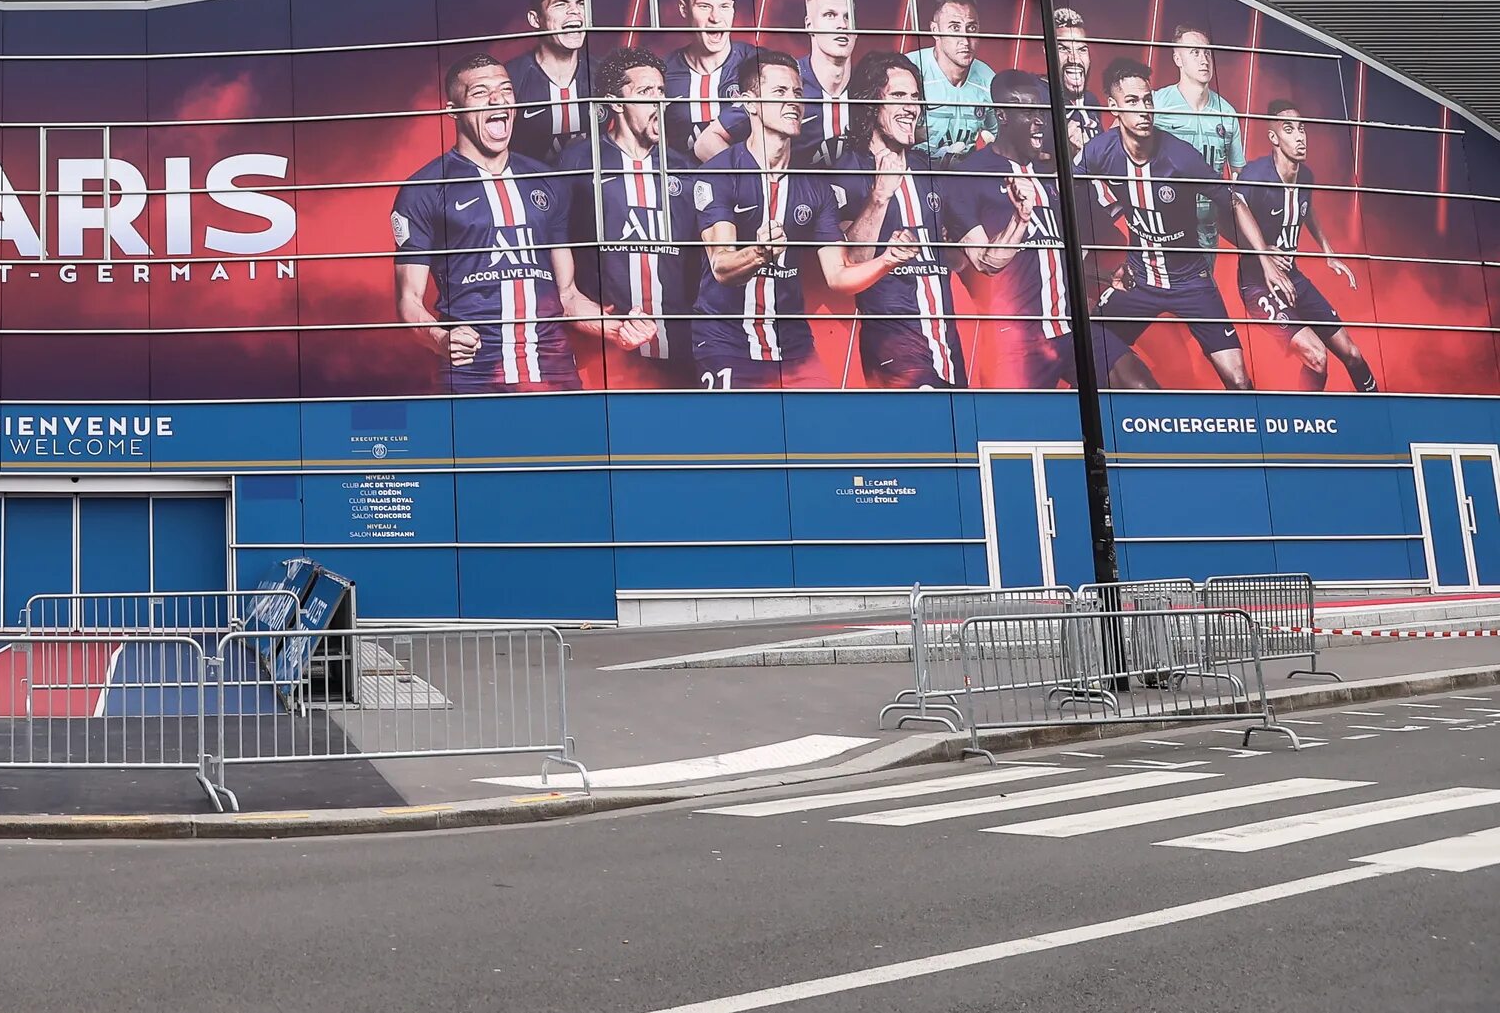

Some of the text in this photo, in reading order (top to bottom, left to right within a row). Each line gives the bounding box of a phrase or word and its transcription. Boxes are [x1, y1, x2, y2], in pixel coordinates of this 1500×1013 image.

[1153, 231, 1185, 242] LIMITLESS
[461, 271, 500, 284] ACCOR
[501, 269, 524, 279] LIVE
[701, 367, 732, 389] 21
[1122, 418, 1338, 434] CONCIERGERIE DU PARC
[10, 439, 143, 455] WELCOME
[874, 478, 898, 486] CARRÉ
[854, 487, 916, 495] CHAMPS-ÉLYSÉES
[874, 495, 898, 503] ÉTOILE
